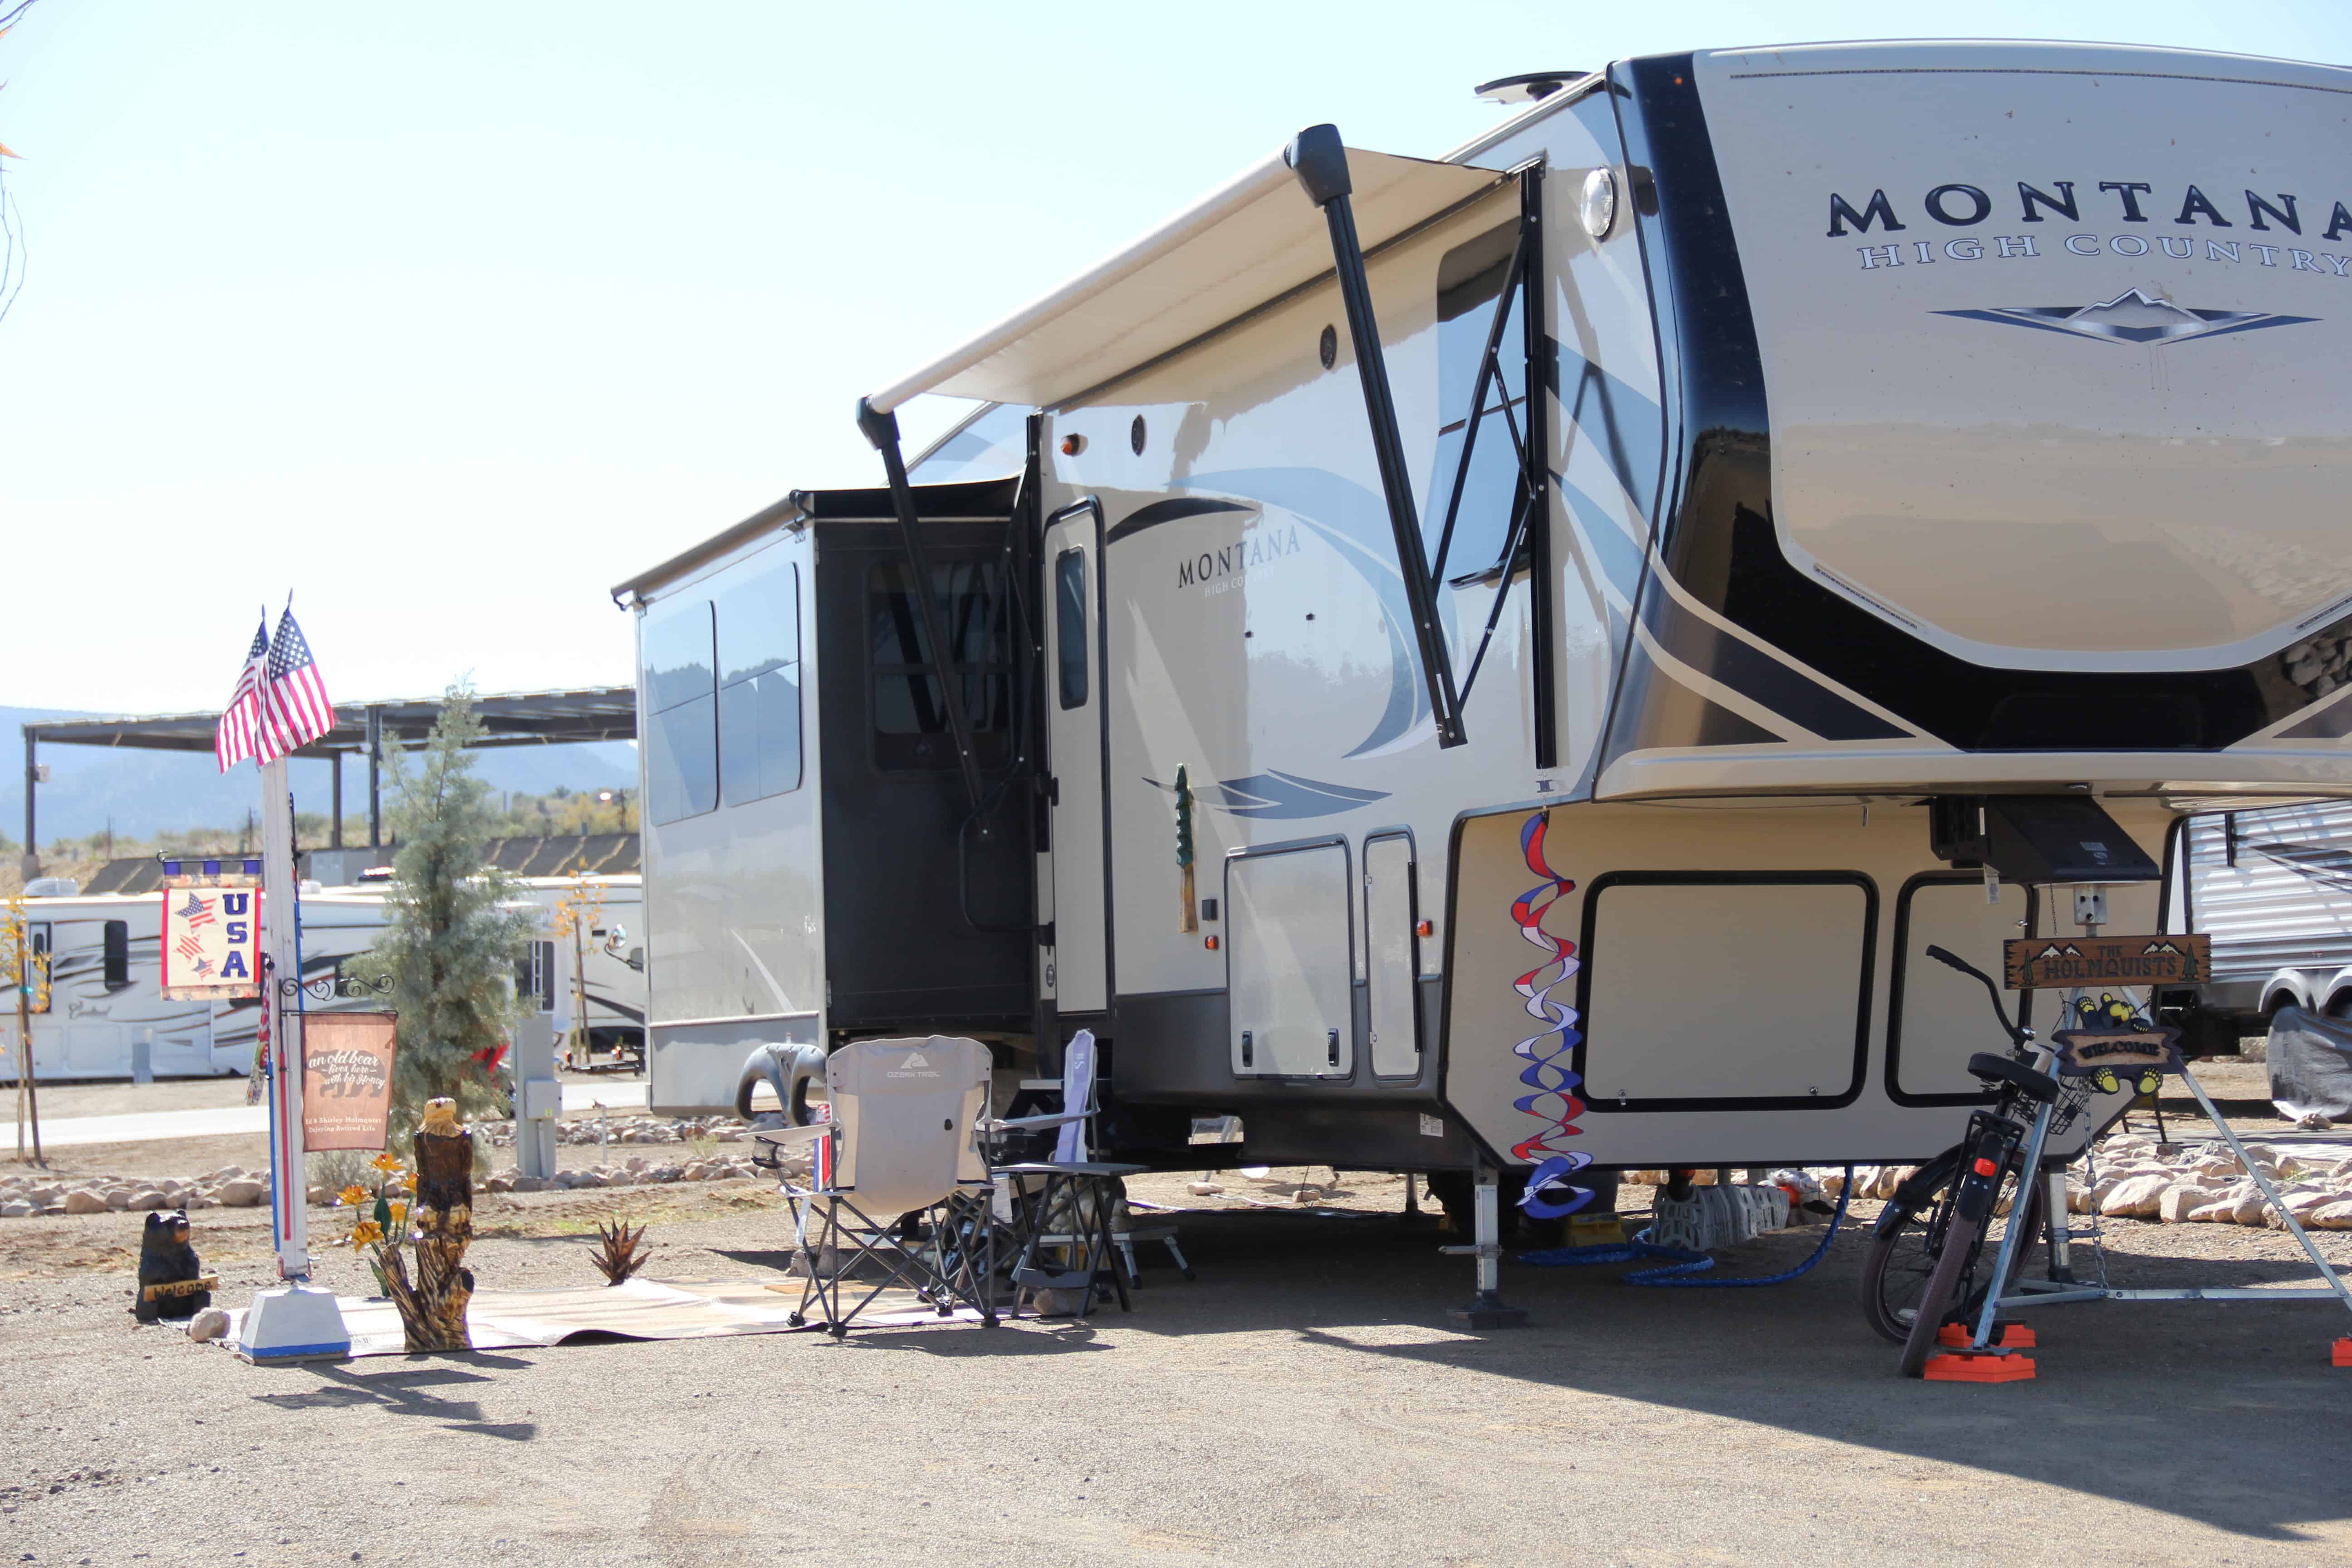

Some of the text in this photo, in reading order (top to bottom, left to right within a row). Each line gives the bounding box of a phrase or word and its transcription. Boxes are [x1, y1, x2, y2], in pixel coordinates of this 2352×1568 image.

[1826, 181, 2352, 242] MONTANA
[1857, 235, 2352, 278] HIGH COUNTRY
[1178, 524, 1301, 589] MONTANA
[1205, 580, 1229, 598] HIGH
[220, 893, 250, 977] USA
[2097, 945, 2123, 958] THE
[2043, 956, 2177, 980] HOLMQUISTS
[2078, 1040, 2160, 1059] WELCOME
[309, 1050, 379, 1068] an old bear
[328, 1063, 369, 1074] lives here
[324, 1072, 386, 1089] with his Honey
[319, 1116, 343, 1124] Shirley
[345, 1116, 382, 1124] Holmquist
